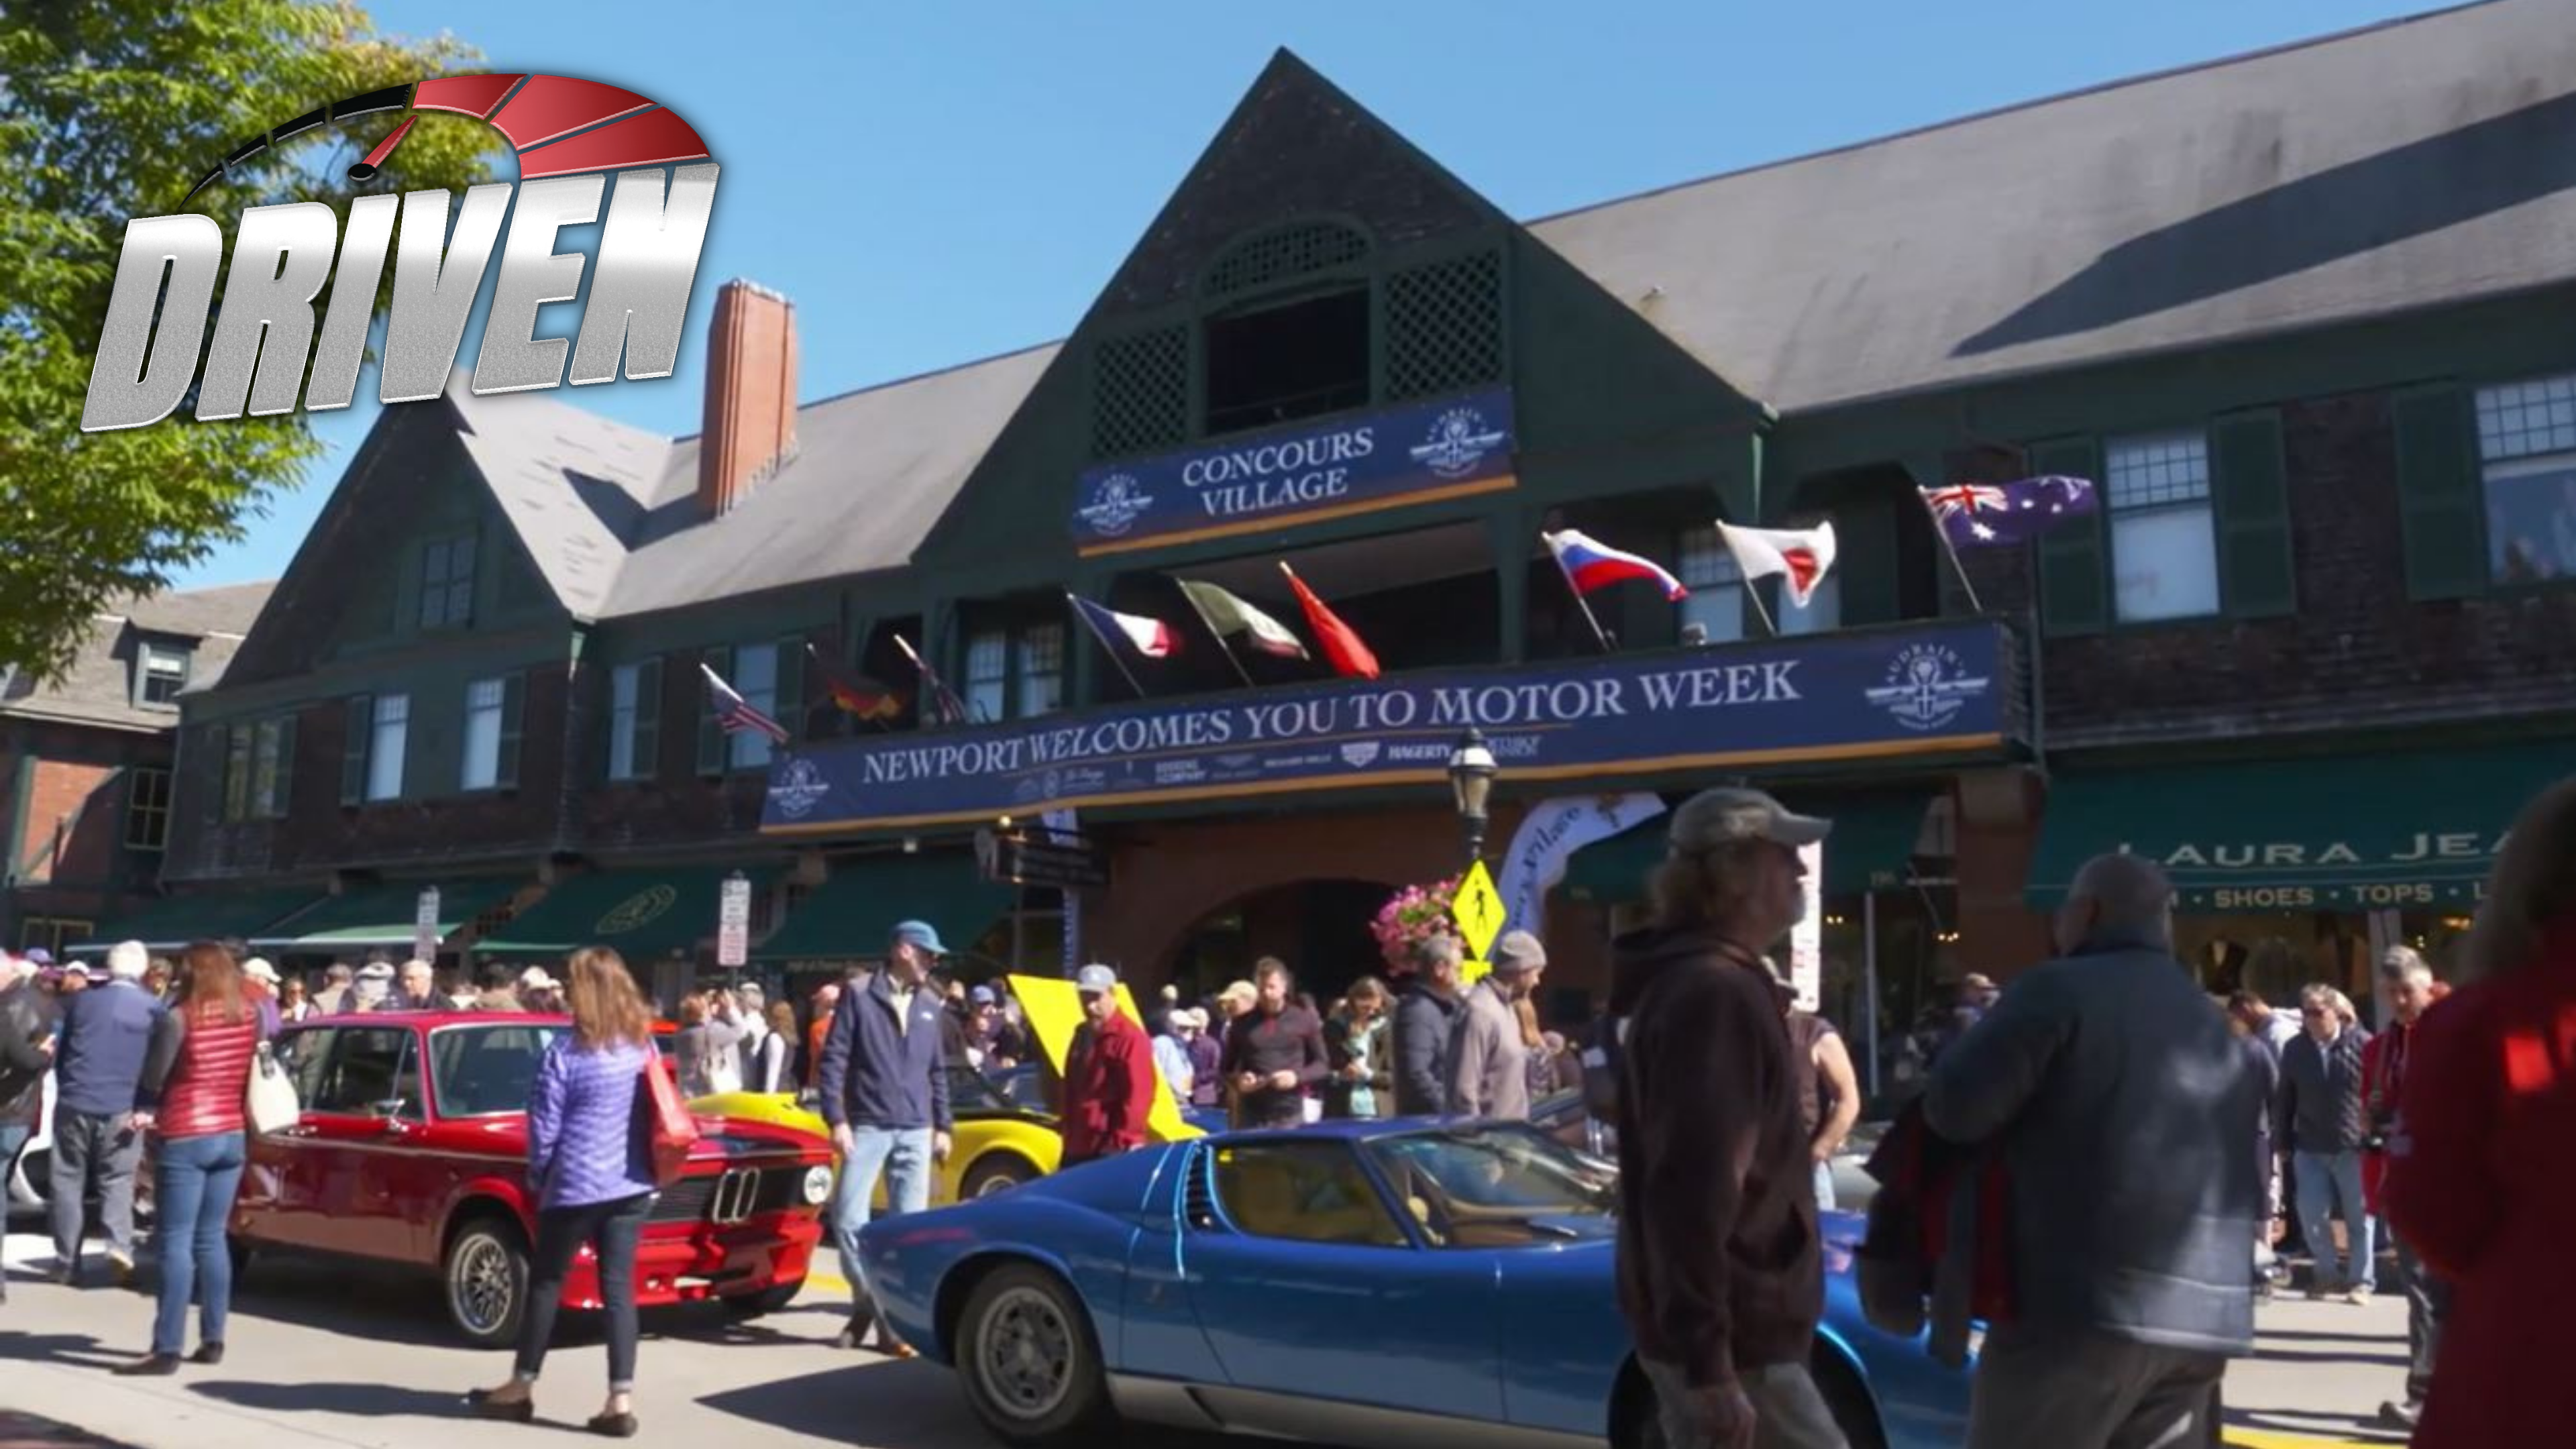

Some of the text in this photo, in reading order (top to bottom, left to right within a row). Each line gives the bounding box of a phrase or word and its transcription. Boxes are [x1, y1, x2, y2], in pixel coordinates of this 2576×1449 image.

[1183, 427, 1374, 487] CONCOURS
[1201, 468, 1349, 517] VILLAGE
[863, 739, 1024, 784] NEWPORT
[1028, 709, 1232, 763] WELCOMES
[1244, 698, 1337, 739] YOU
[1348, 690, 1416, 728] TO
[1428, 679, 1627, 725] MOTOR
[1639, 659, 1803, 711] WEEK
[1388, 743, 1454, 760] HAGERTY
[2214, 882, 2434, 908] SHOES TOPS
